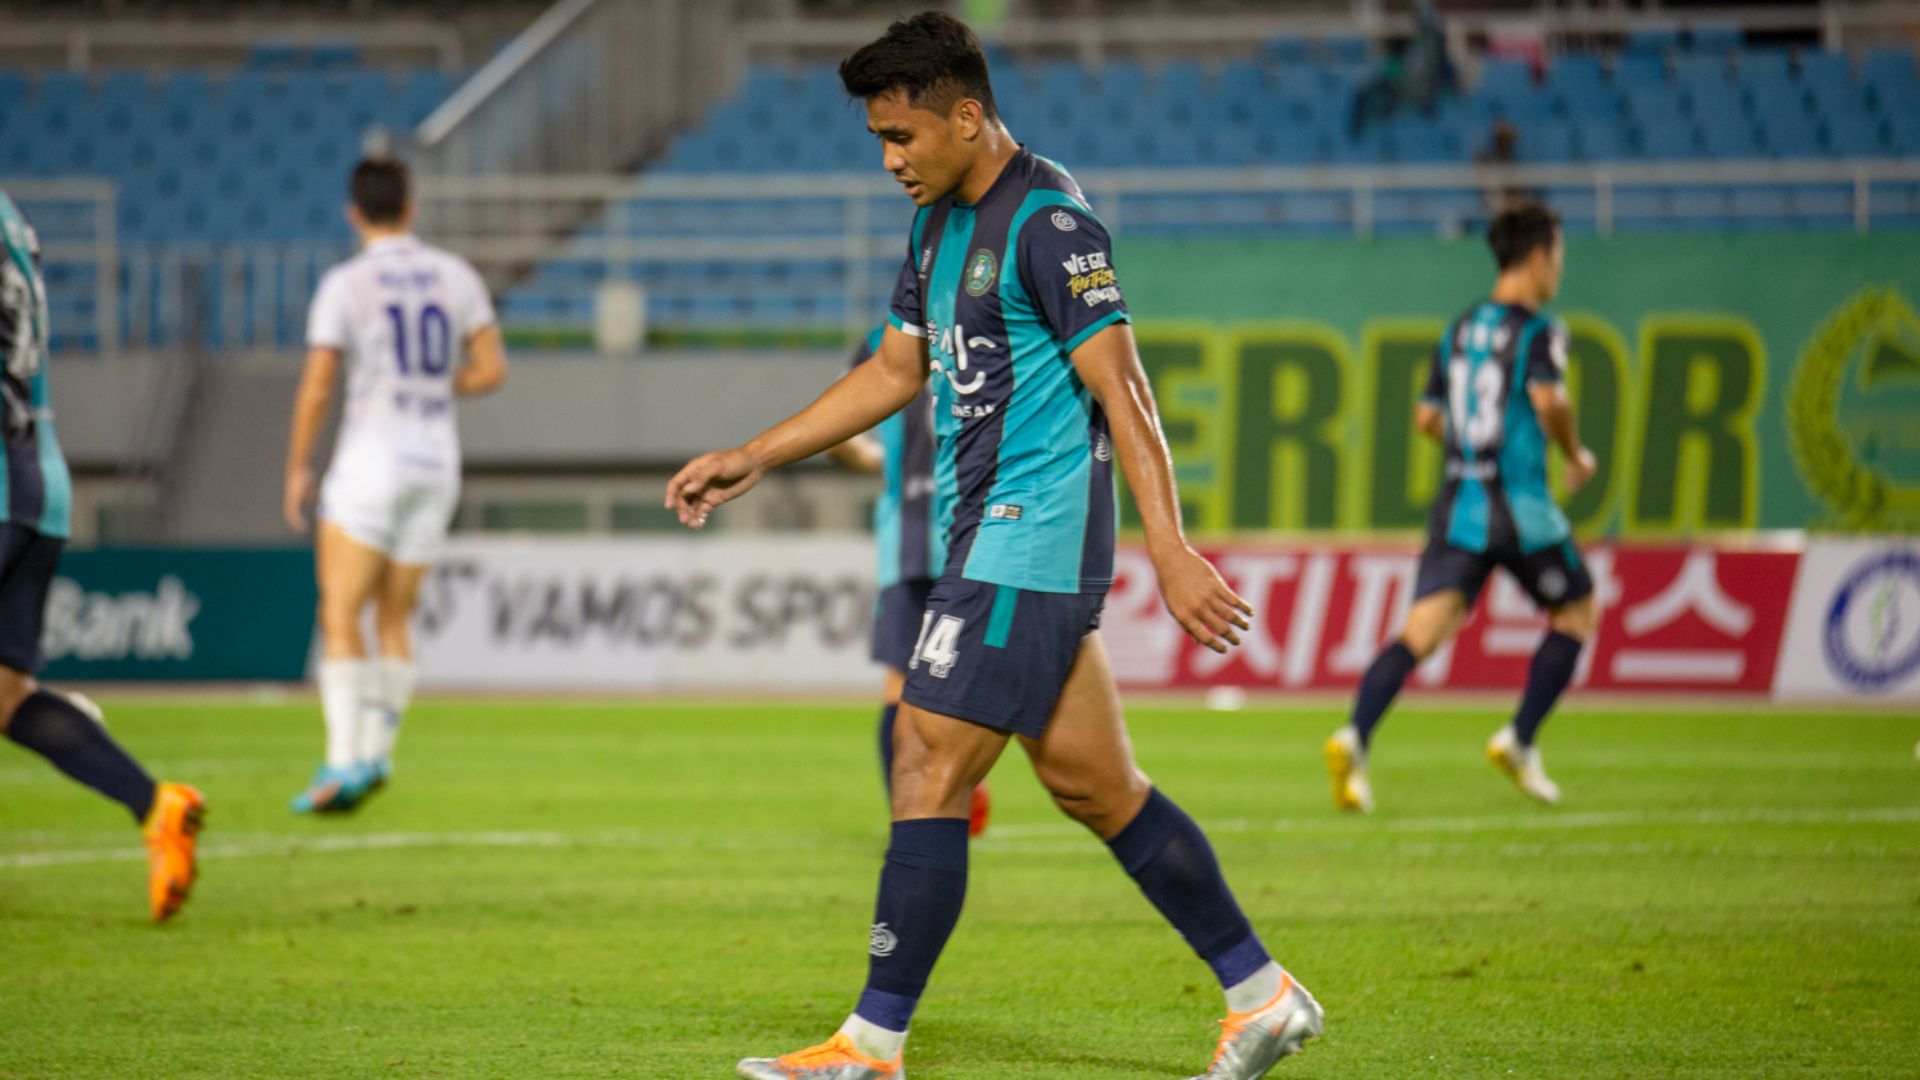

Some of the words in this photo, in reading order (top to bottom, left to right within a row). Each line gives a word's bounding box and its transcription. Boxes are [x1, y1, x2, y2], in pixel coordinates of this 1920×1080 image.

[385, 303, 451, 376] 10
[1447, 357, 1505, 447] 13
[487, 574, 715, 646] VAMOS
